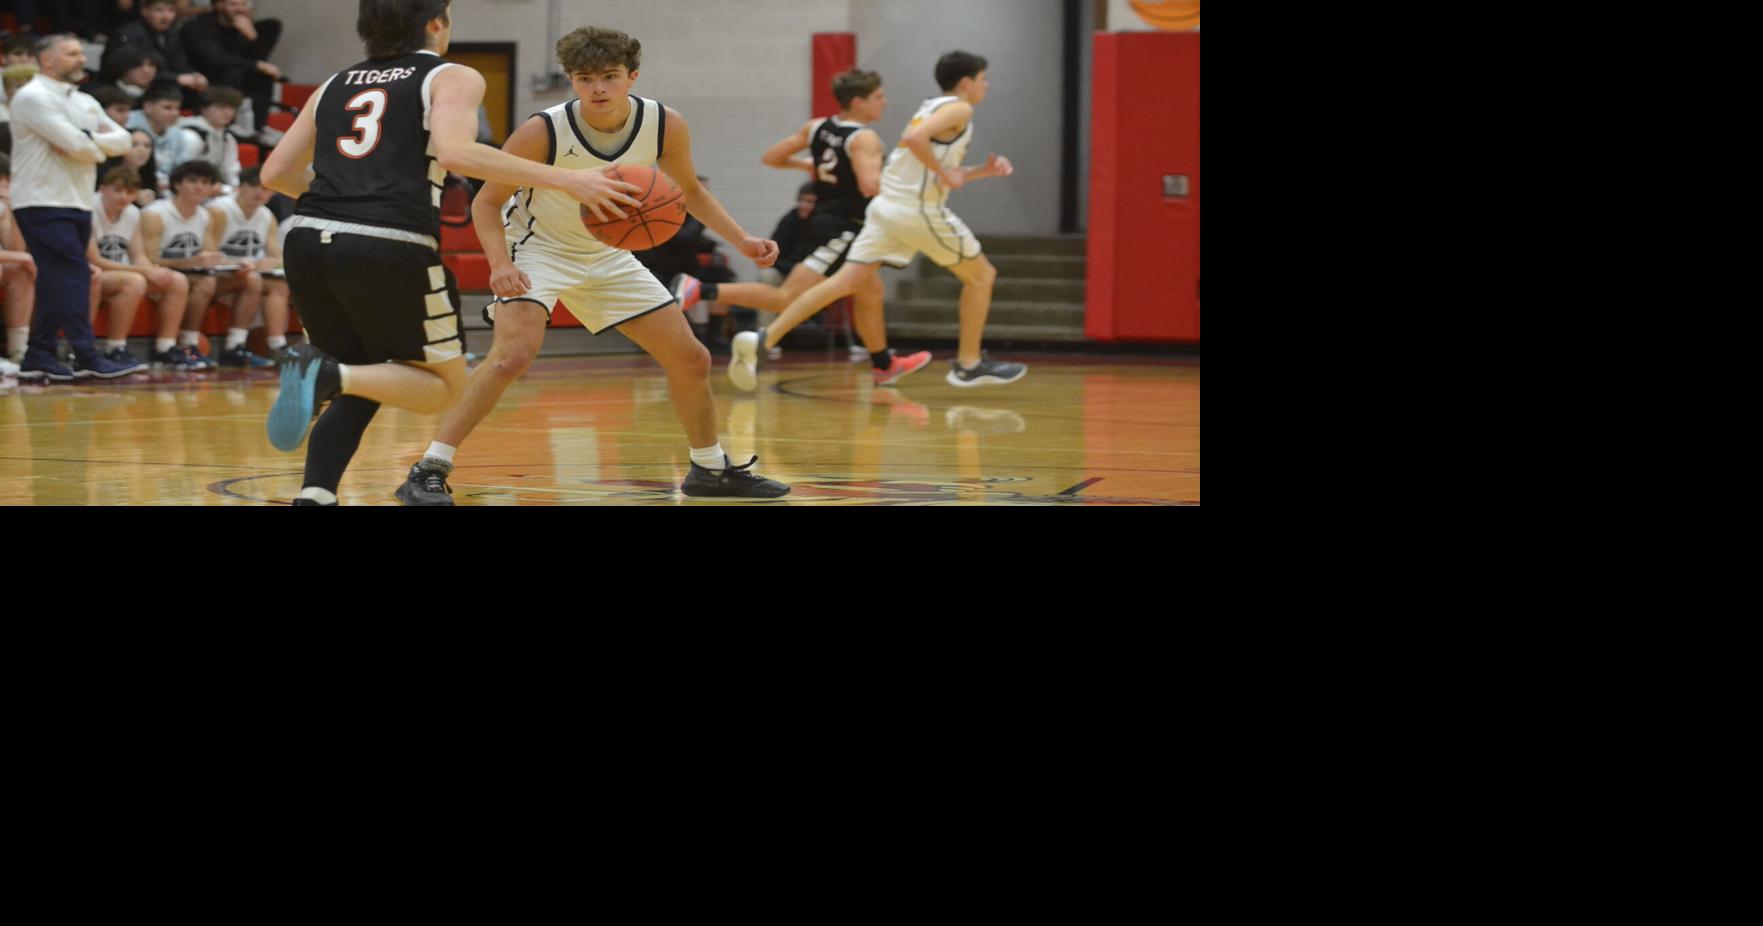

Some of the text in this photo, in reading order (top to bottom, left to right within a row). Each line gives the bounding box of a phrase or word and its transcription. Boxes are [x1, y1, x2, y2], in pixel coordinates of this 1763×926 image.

[344, 66, 416, 85] TIGERS
[336, 88, 389, 159] 3
[817, 147, 839, 184] 2
